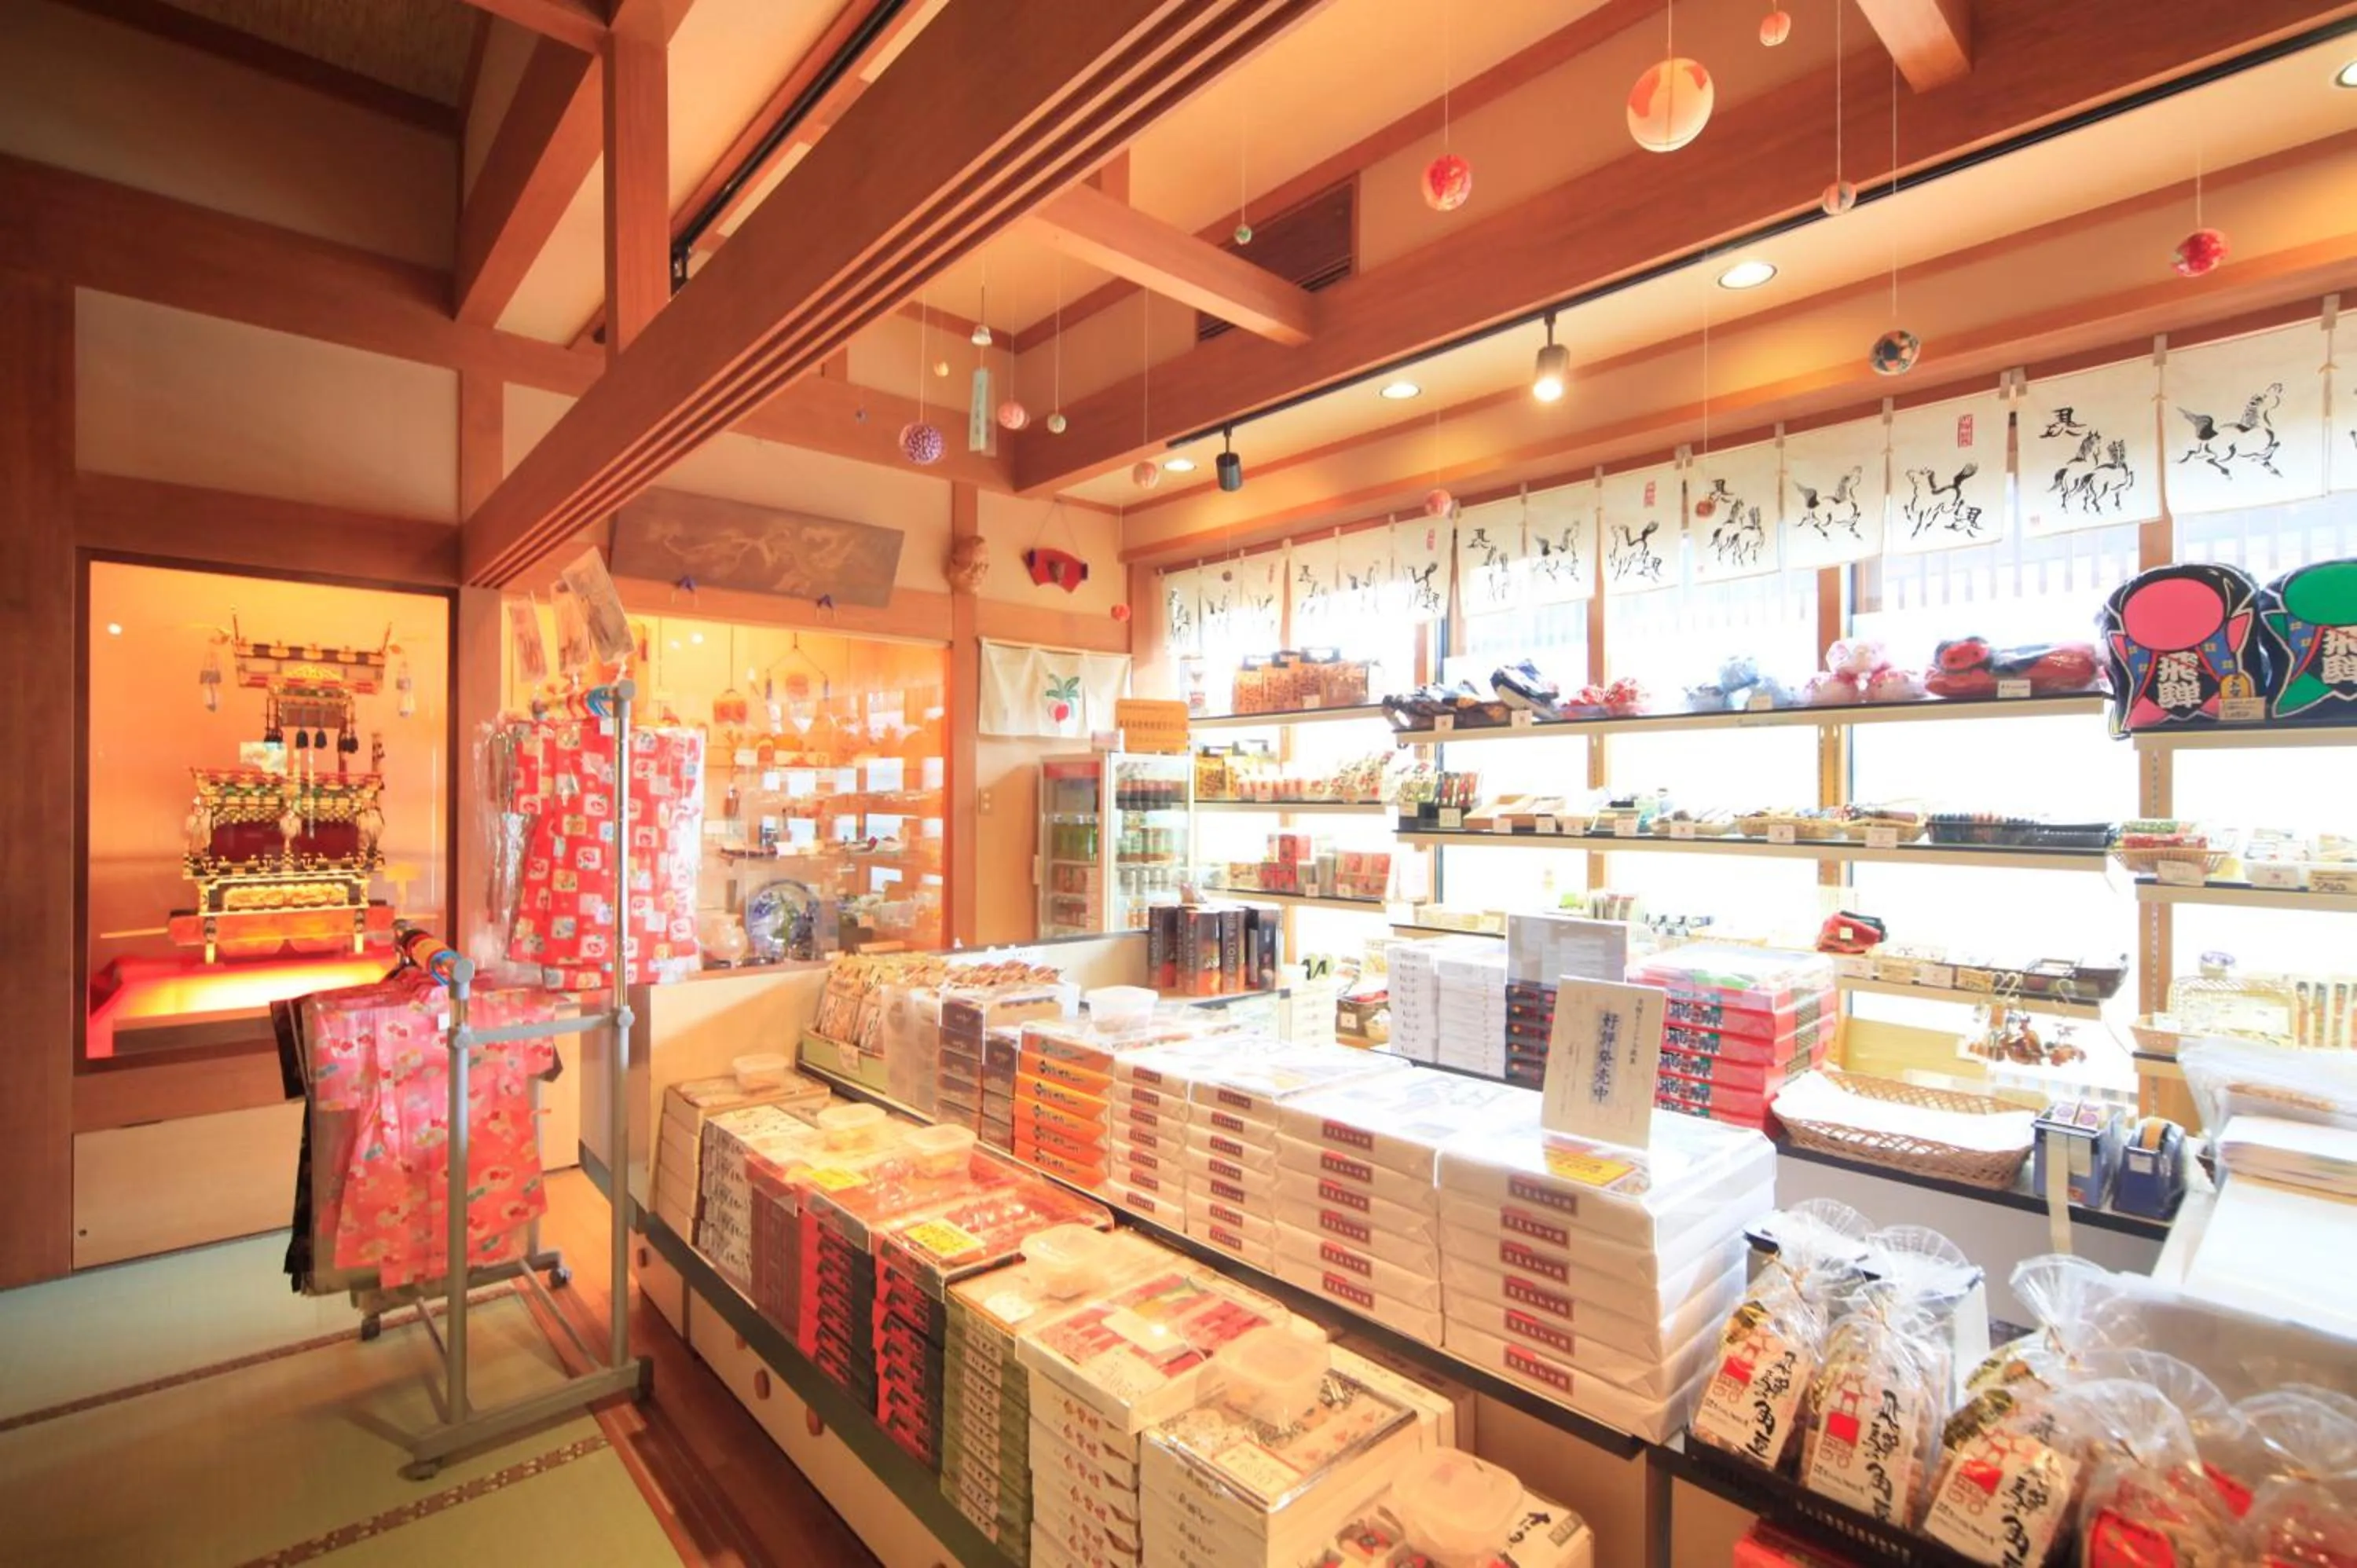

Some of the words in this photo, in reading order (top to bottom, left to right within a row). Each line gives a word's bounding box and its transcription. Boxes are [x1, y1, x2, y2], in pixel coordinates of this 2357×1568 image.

[2157, 651, 2202, 709] 飛騨
[1592, 1011, 1620, 1104] 好評発売中
